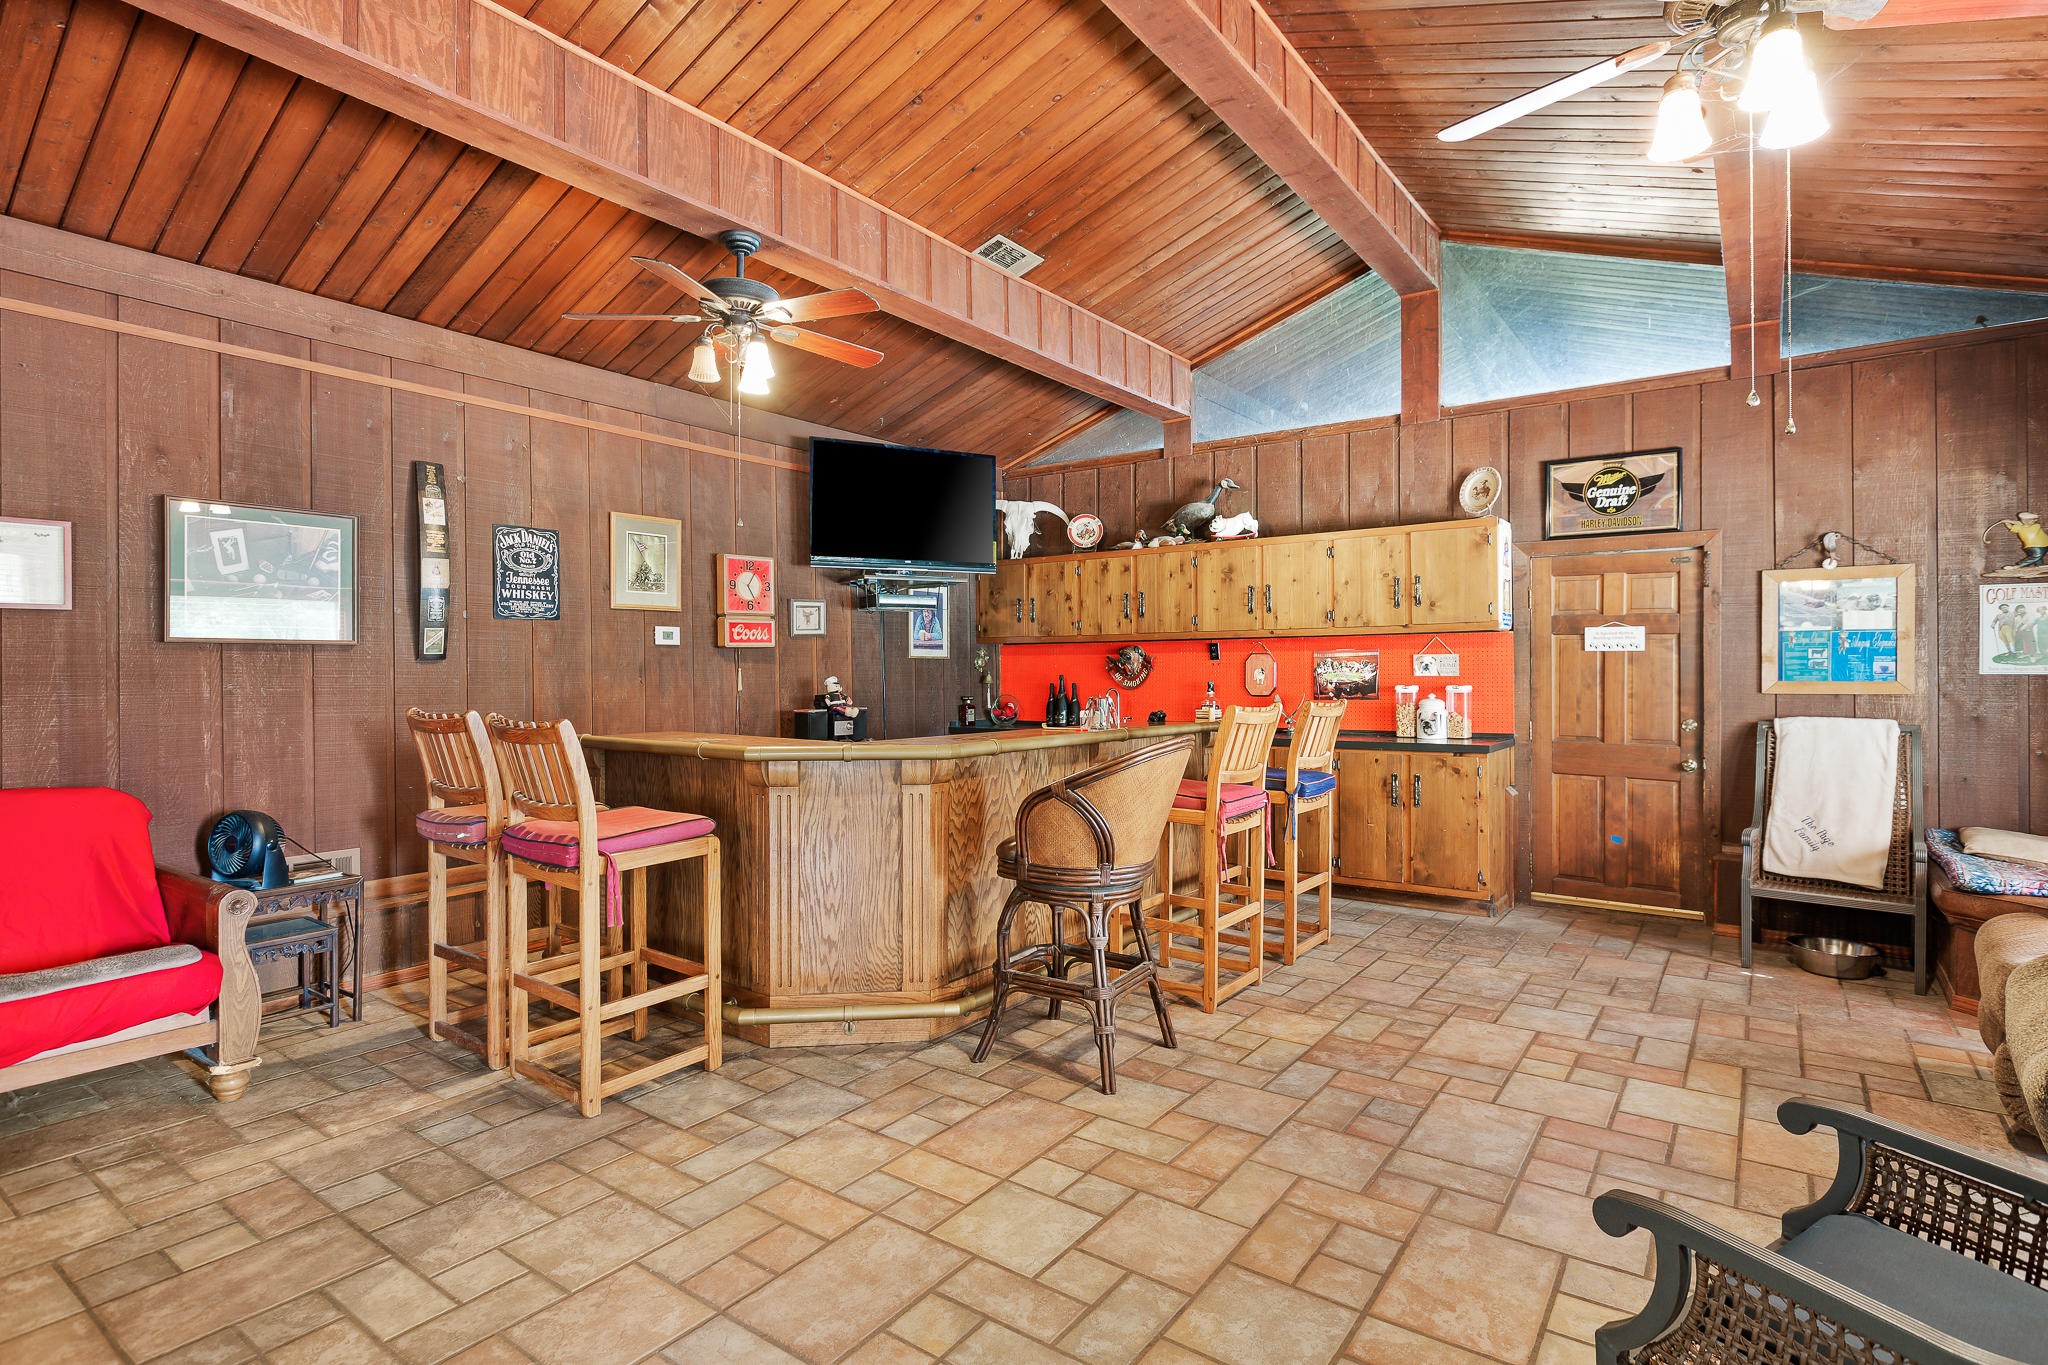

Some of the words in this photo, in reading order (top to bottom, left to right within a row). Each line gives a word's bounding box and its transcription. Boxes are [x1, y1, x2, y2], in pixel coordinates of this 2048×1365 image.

[1594, 471, 1627, 487] Miller
[1587, 484, 1636, 499] Genuine
[1595, 496, 1628, 508] Draft
[500, 532, 520, 549] JACK
[520, 551, 535, 559] Old
[745, 560, 755, 571] 12
[506, 571, 550, 586] Tennessee
[729, 579, 736, 590] 9
[501, 589, 555, 600] WHISKEY
[765, 582, 771, 592] 3
[1986, 587, 2017, 605] GOLF
[747, 600, 754, 611] 6
[732, 623, 769, 640] Coors
[1114, 672, 1123, 681] NO
[1122, 668, 1149, 688] SMOKING
[1801, 815, 1817, 830] The
[1793, 827, 1820, 852] Family
